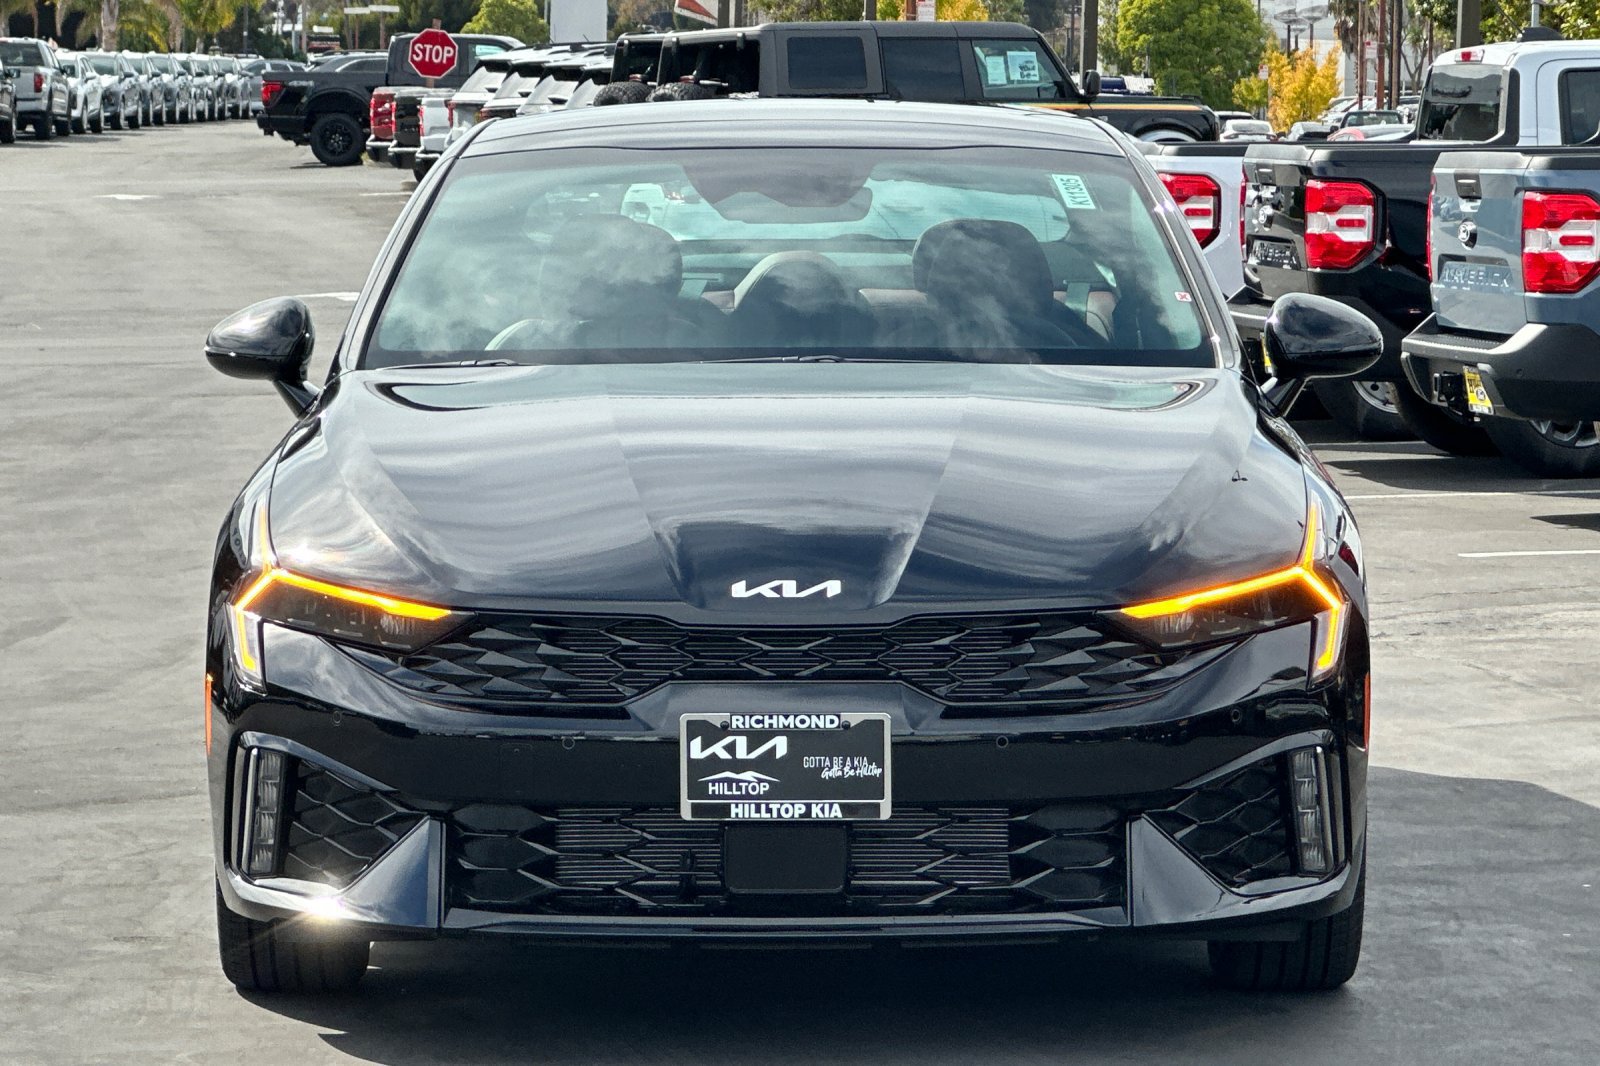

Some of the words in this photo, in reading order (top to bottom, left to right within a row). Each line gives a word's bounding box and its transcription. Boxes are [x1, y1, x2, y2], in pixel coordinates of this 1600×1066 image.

[412, 43, 454, 64] STOP
[731, 580, 841, 598] KIA
[731, 714, 839, 729] RICHMOND
[690, 735, 788, 760] KIA
[803, 756, 831, 768] GOTTA
[833, 756, 843, 768] BE
[845, 756, 852, 768] A
[854, 756, 869, 768] KIA
[821, 764, 843, 780] Gotta
[843, 765, 856, 779] Be
[856, 761, 883, 778] Hilltop
[708, 782, 770, 796] HILLTOP
[730, 803, 806, 819] HILLTOP
[811, 803, 843, 819] KIA
